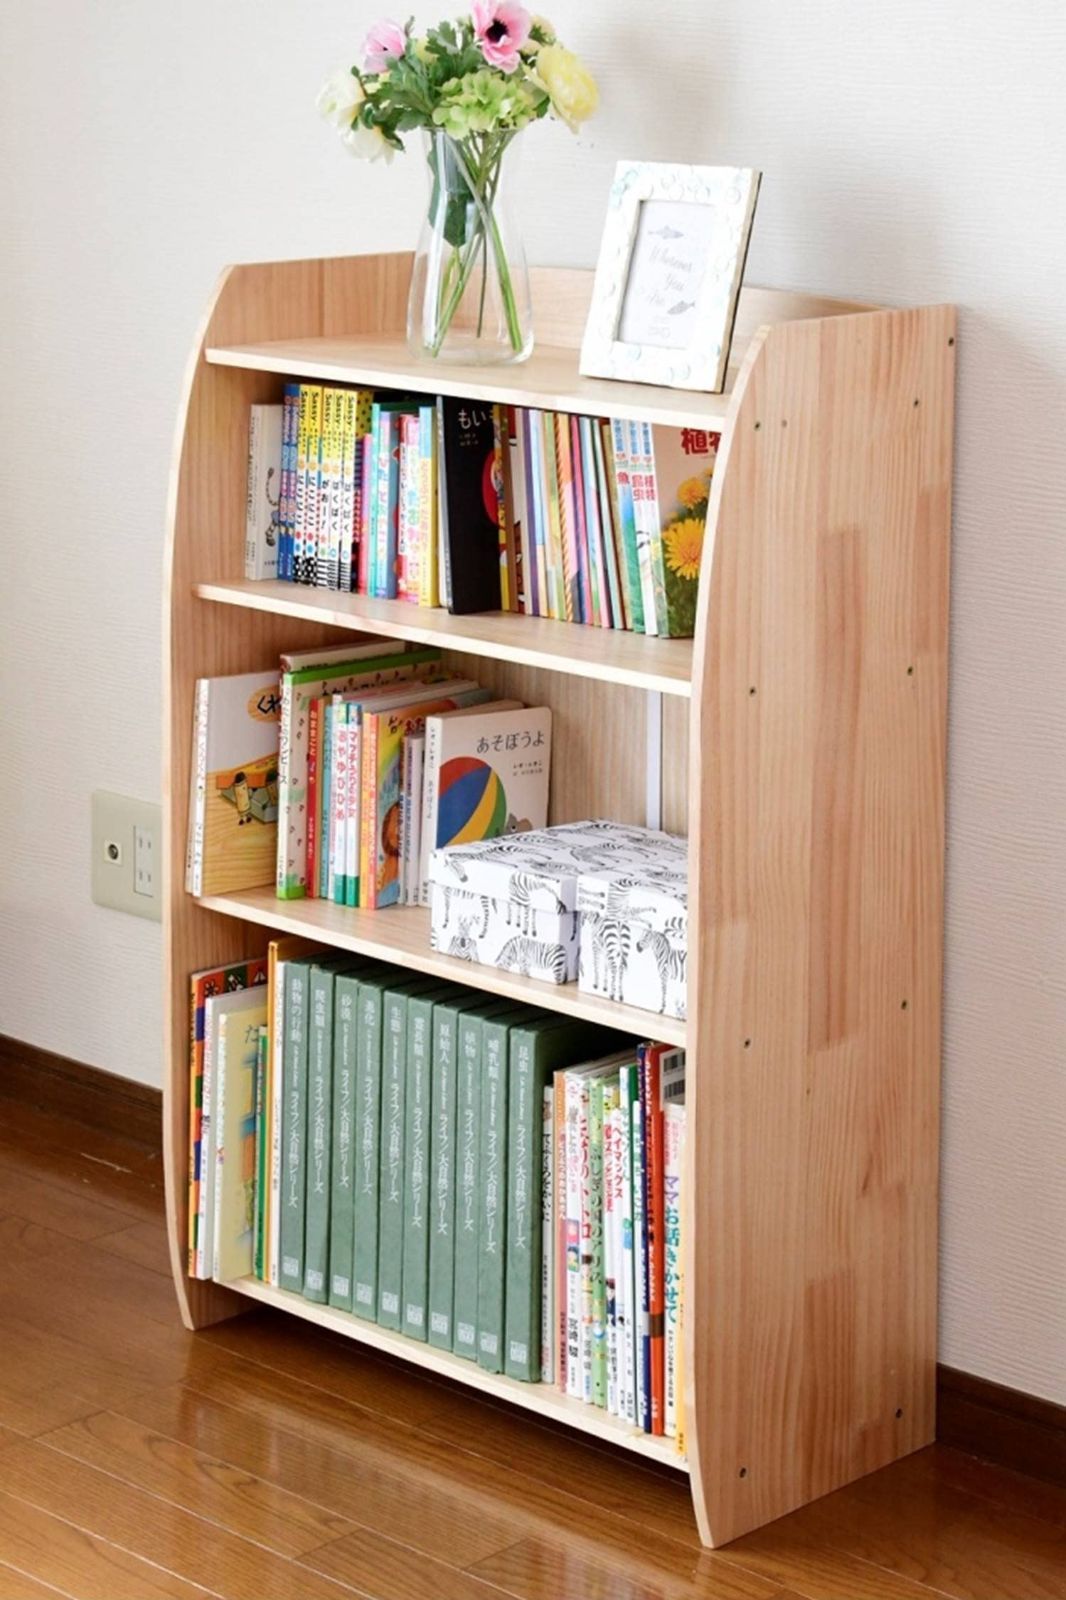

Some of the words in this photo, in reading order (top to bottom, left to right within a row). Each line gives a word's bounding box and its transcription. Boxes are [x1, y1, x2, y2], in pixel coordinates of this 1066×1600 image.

[476, 730, 545, 754] あそぼうよ
[664, 1174, 680, 1324] ママお話きかせて
